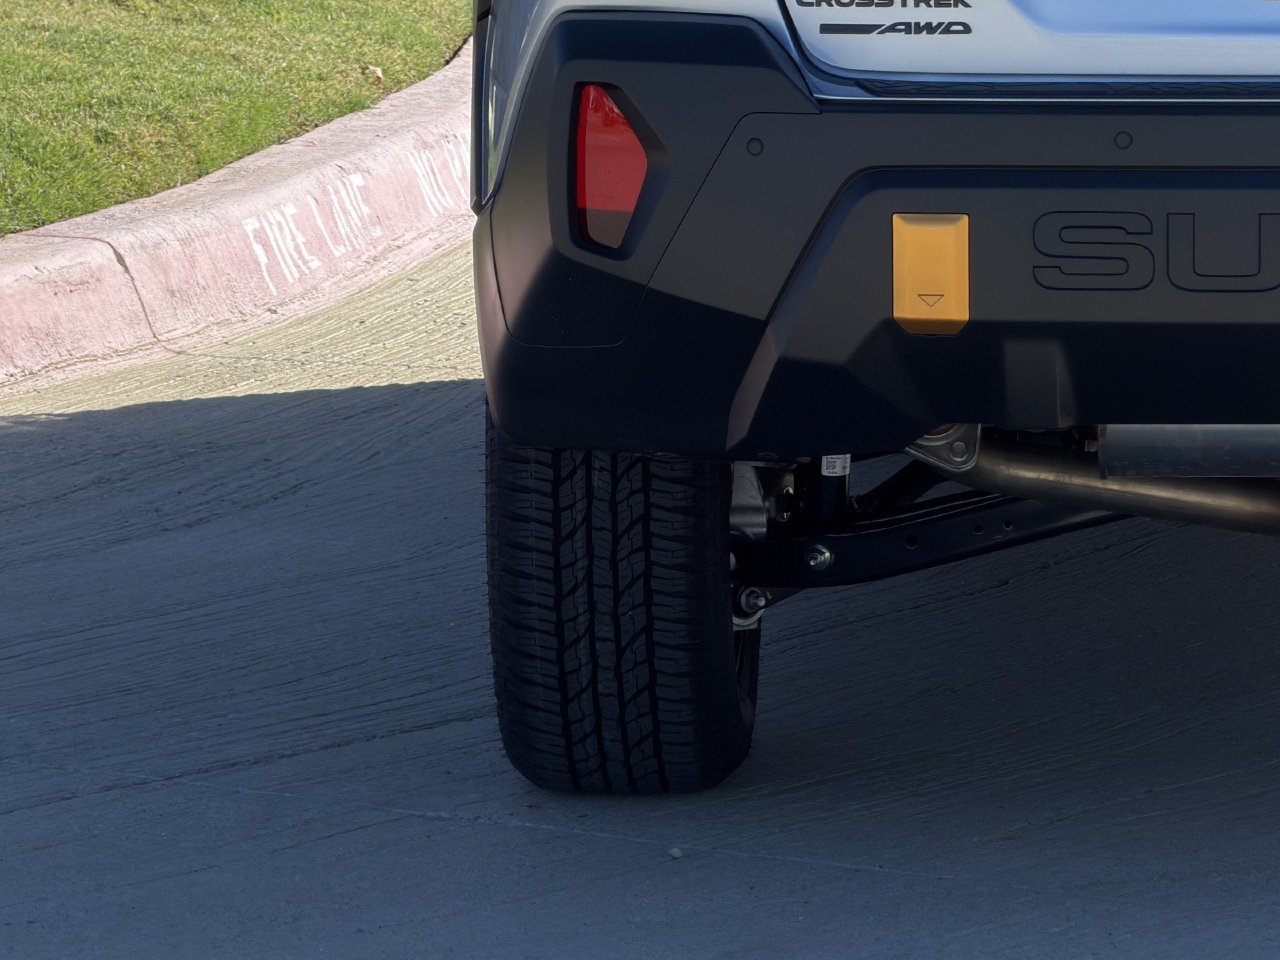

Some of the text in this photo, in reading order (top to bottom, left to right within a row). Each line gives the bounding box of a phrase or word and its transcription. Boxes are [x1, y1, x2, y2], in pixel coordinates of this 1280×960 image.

[875, 21, 972, 35] AWD
[241, 201, 322, 297] FIRE
[307, 171, 383, 258] LANE
